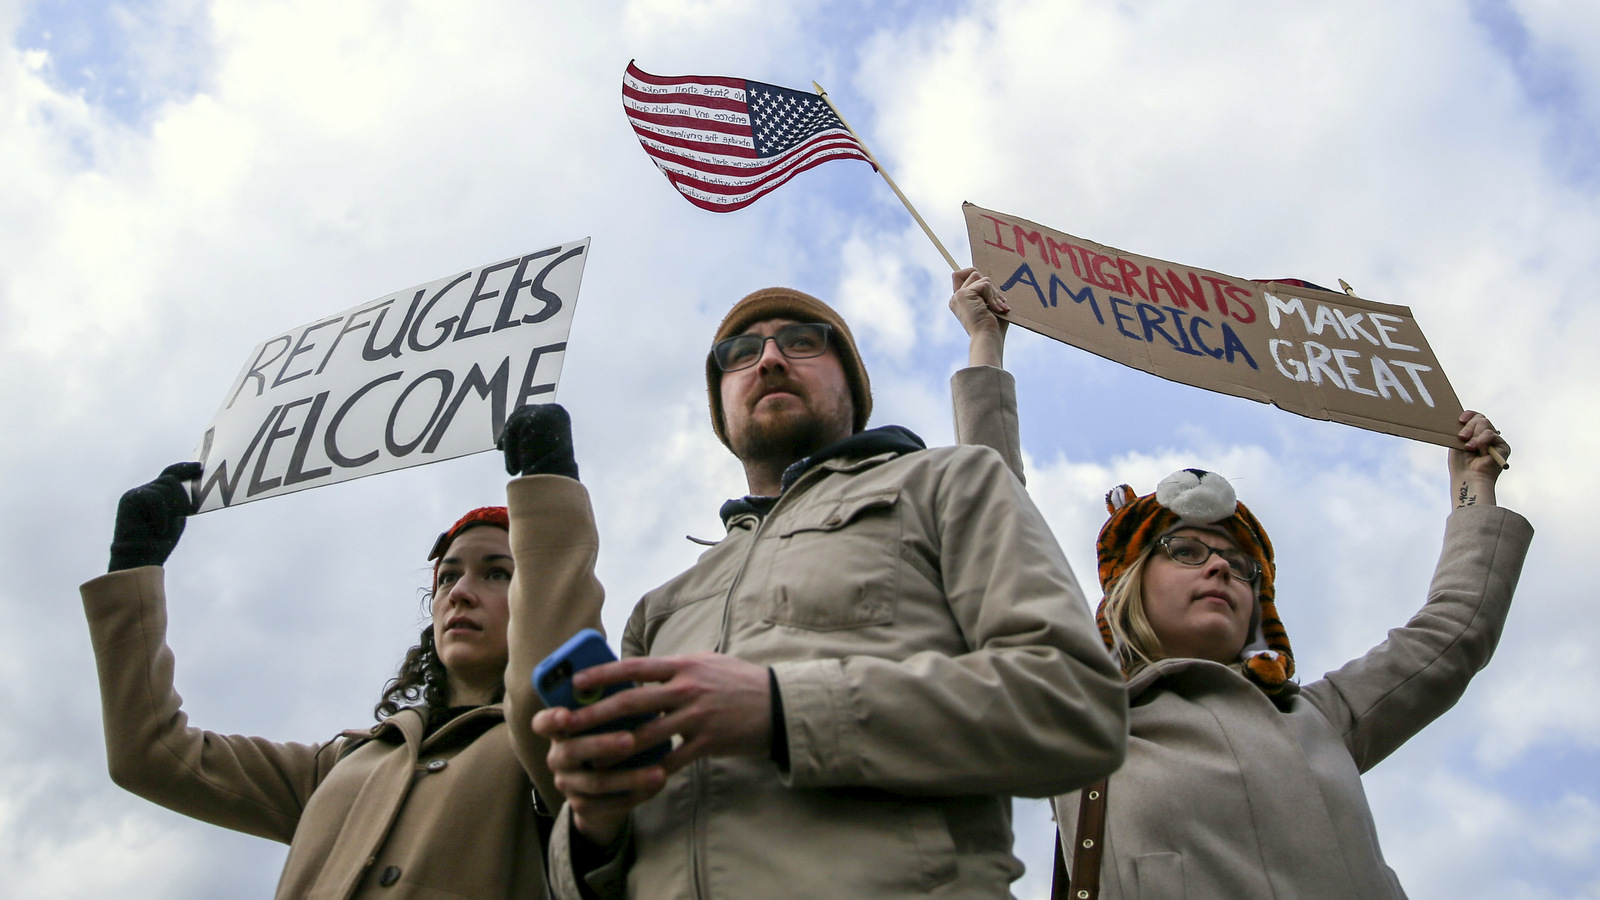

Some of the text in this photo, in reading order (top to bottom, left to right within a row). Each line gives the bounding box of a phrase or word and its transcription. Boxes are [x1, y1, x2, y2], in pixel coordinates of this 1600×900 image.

[226, 246, 585, 411] REFUGEES
[980, 214, 1421, 353] IMMIGRANTS MAKE
[1000, 262, 1433, 408] AMERICA GREAT
[192, 342, 567, 513] WELCOME
